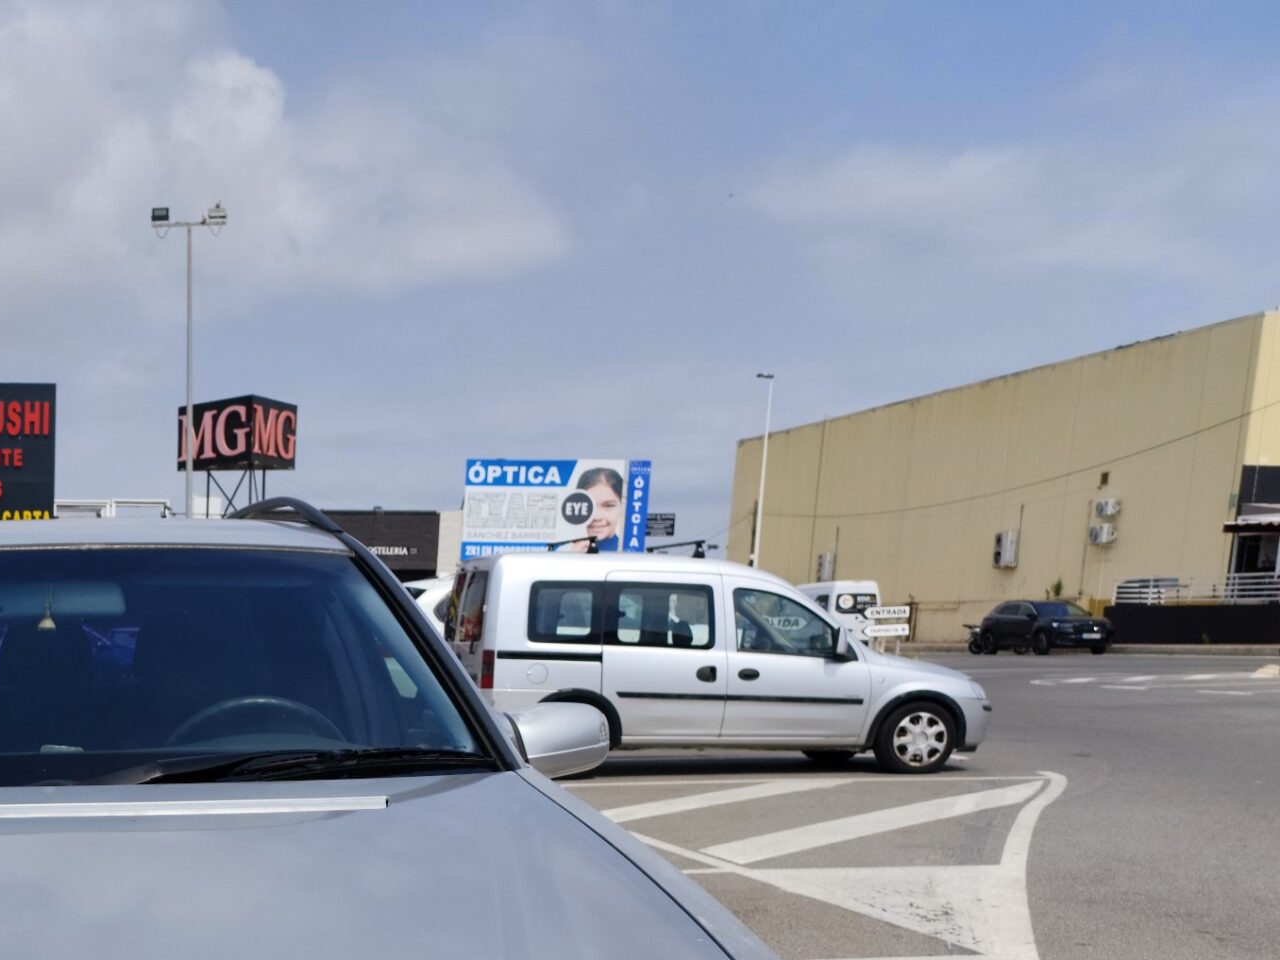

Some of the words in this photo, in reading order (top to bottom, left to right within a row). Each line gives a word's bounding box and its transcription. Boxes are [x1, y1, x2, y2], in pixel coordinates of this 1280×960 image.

[178, 404, 250, 462] MG
[252, 404, 296, 460] MG
[468, 461, 562, 485] ÓPTICA
[565, 501, 589, 517] EYE
[368, 546, 408, 555] OSTELERIA
[870, 608, 907, 616] ENTRADA
